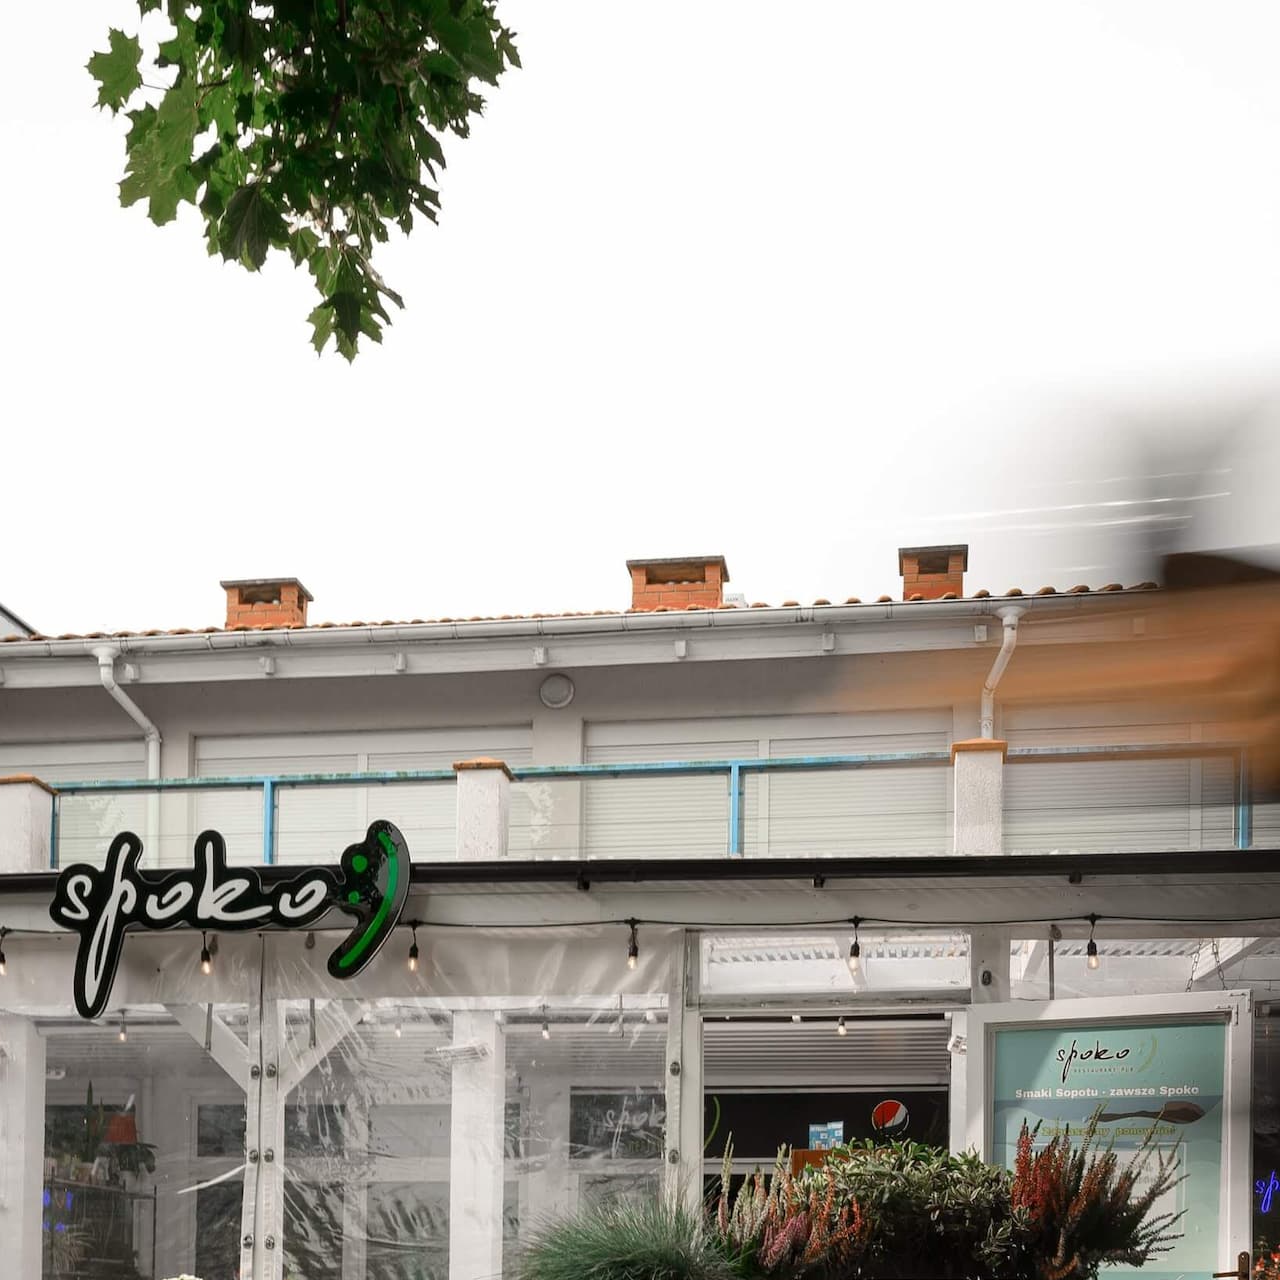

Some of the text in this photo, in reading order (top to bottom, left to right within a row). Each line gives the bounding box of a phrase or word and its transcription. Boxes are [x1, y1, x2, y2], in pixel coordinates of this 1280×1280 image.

[1015, 1084, 1199, 1099] Smaki Sopotu zawsze Spoko
